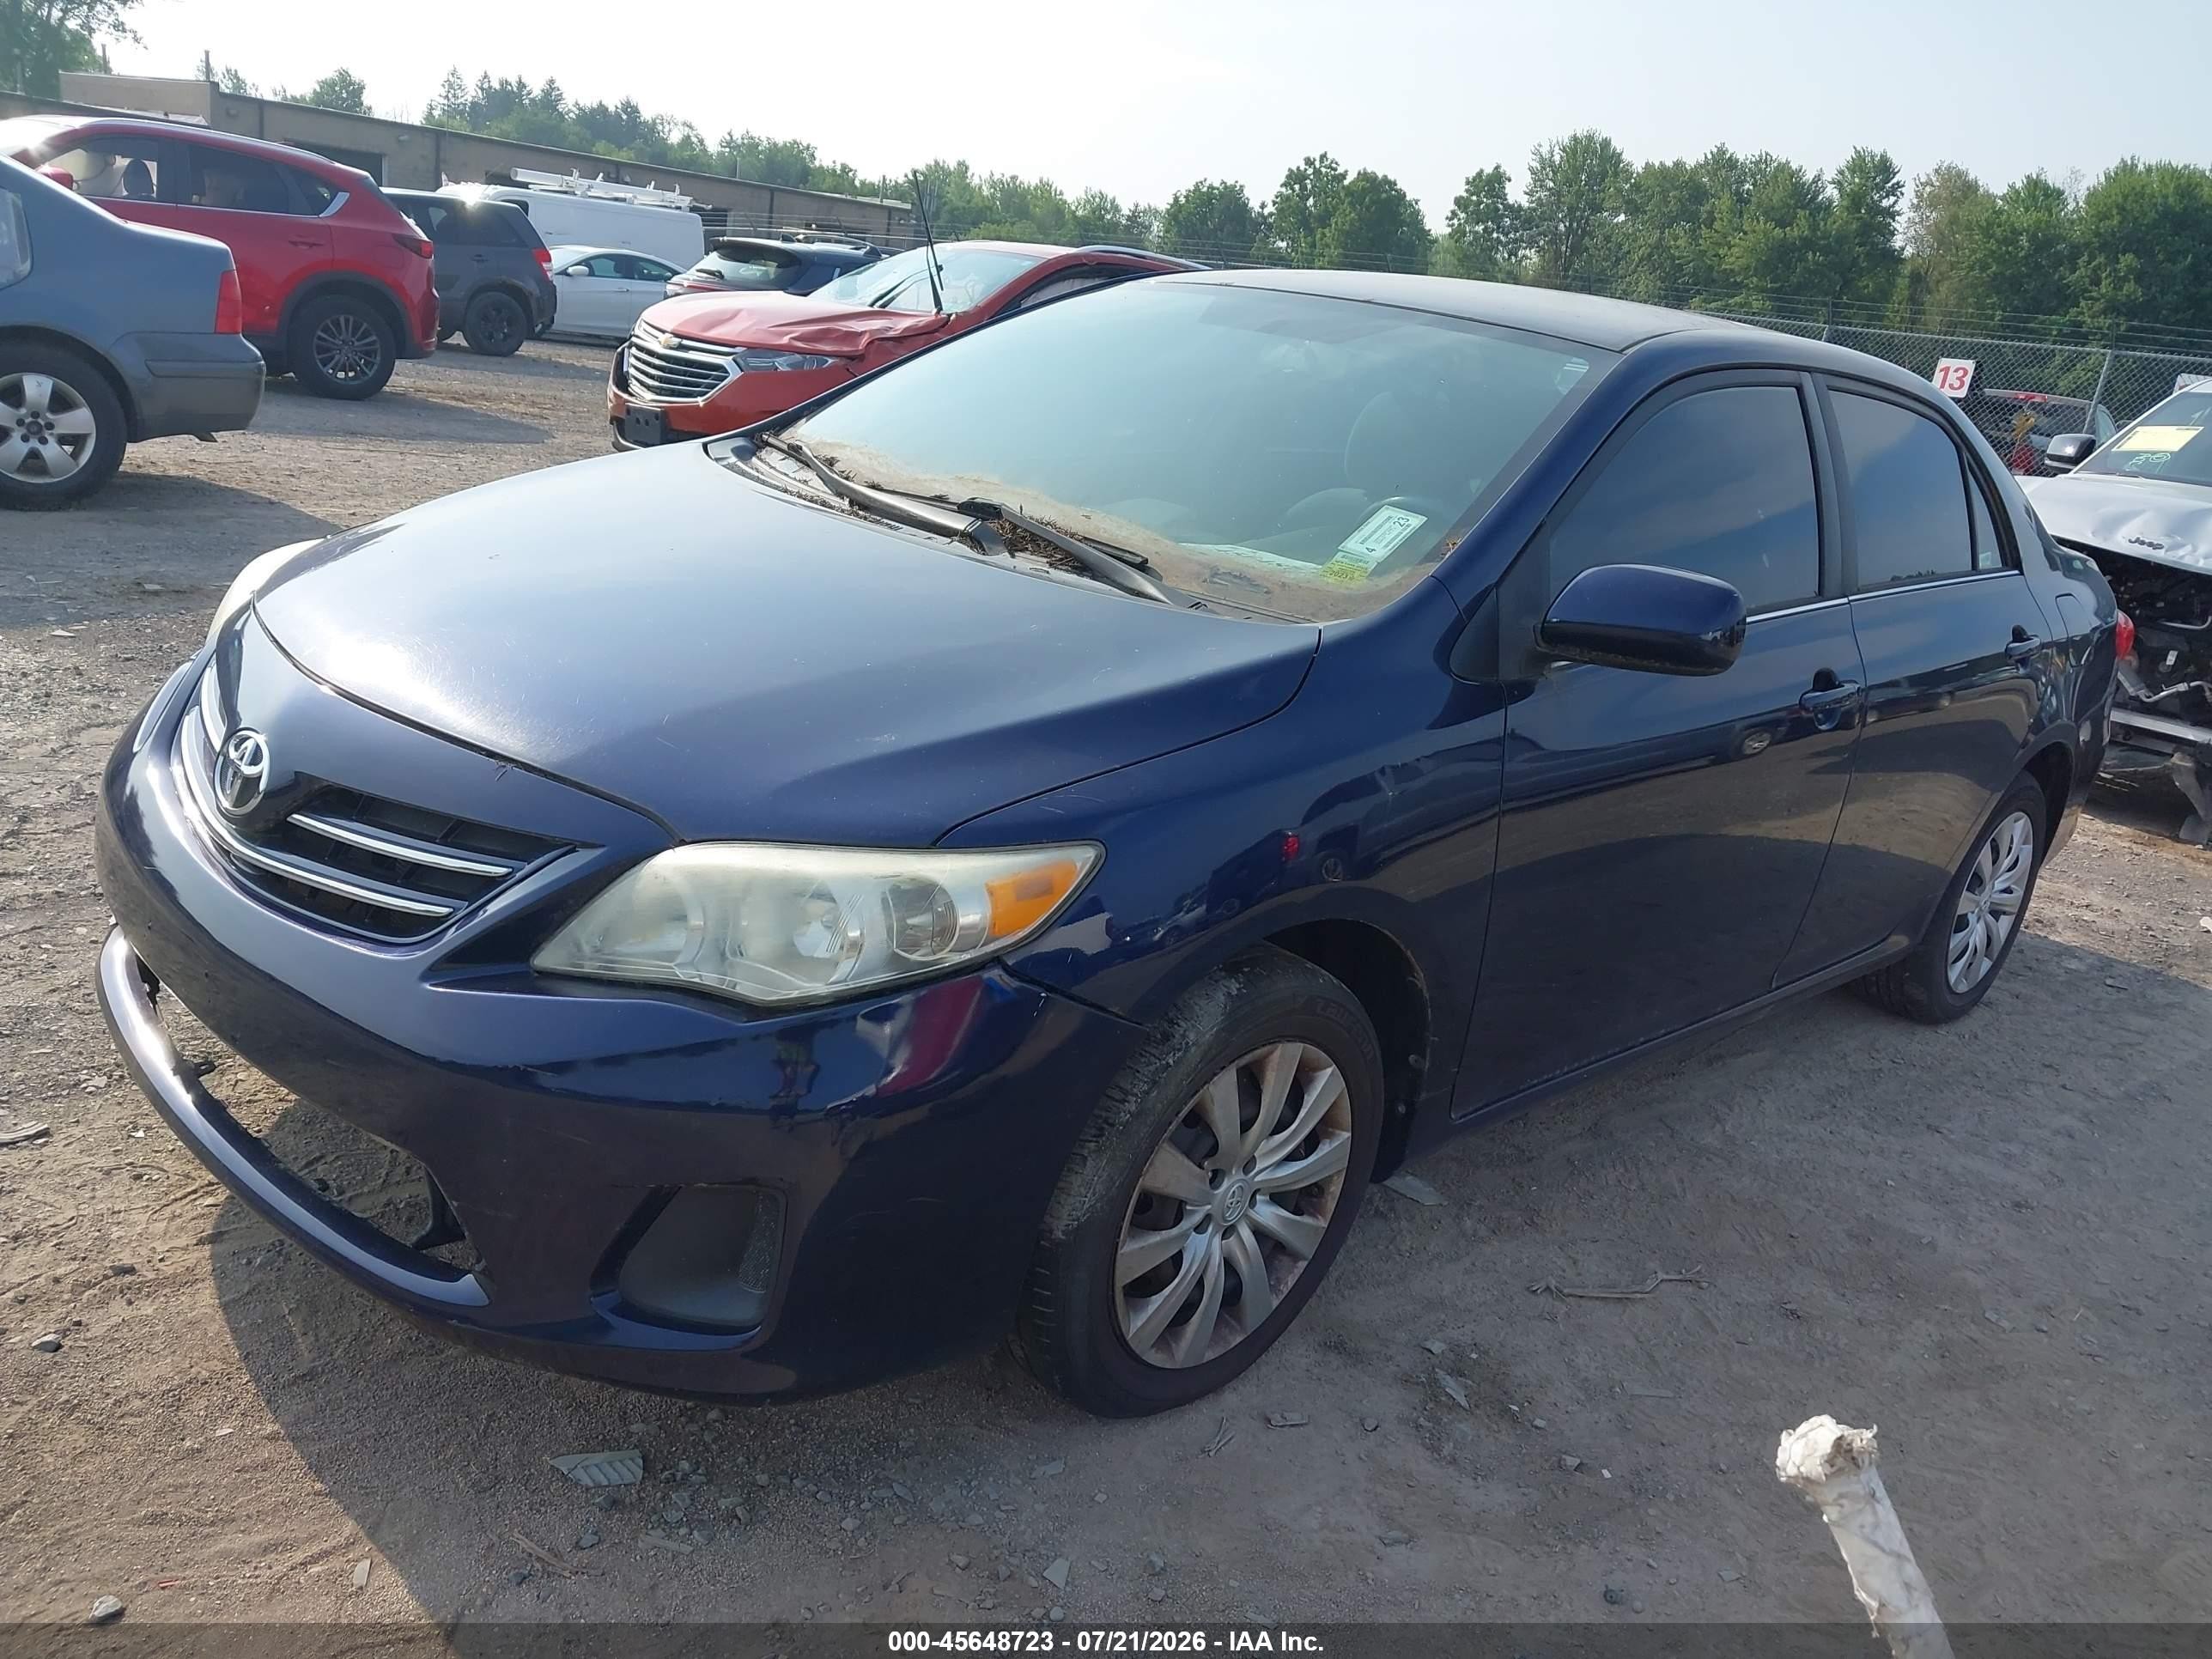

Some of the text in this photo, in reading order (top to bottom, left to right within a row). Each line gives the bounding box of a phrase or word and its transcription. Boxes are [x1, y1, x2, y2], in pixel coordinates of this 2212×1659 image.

[1938, 366, 1969, 391] 13
[1393, 516, 1410, 527] 23
[2128, 536, 2165, 550] Jeep
